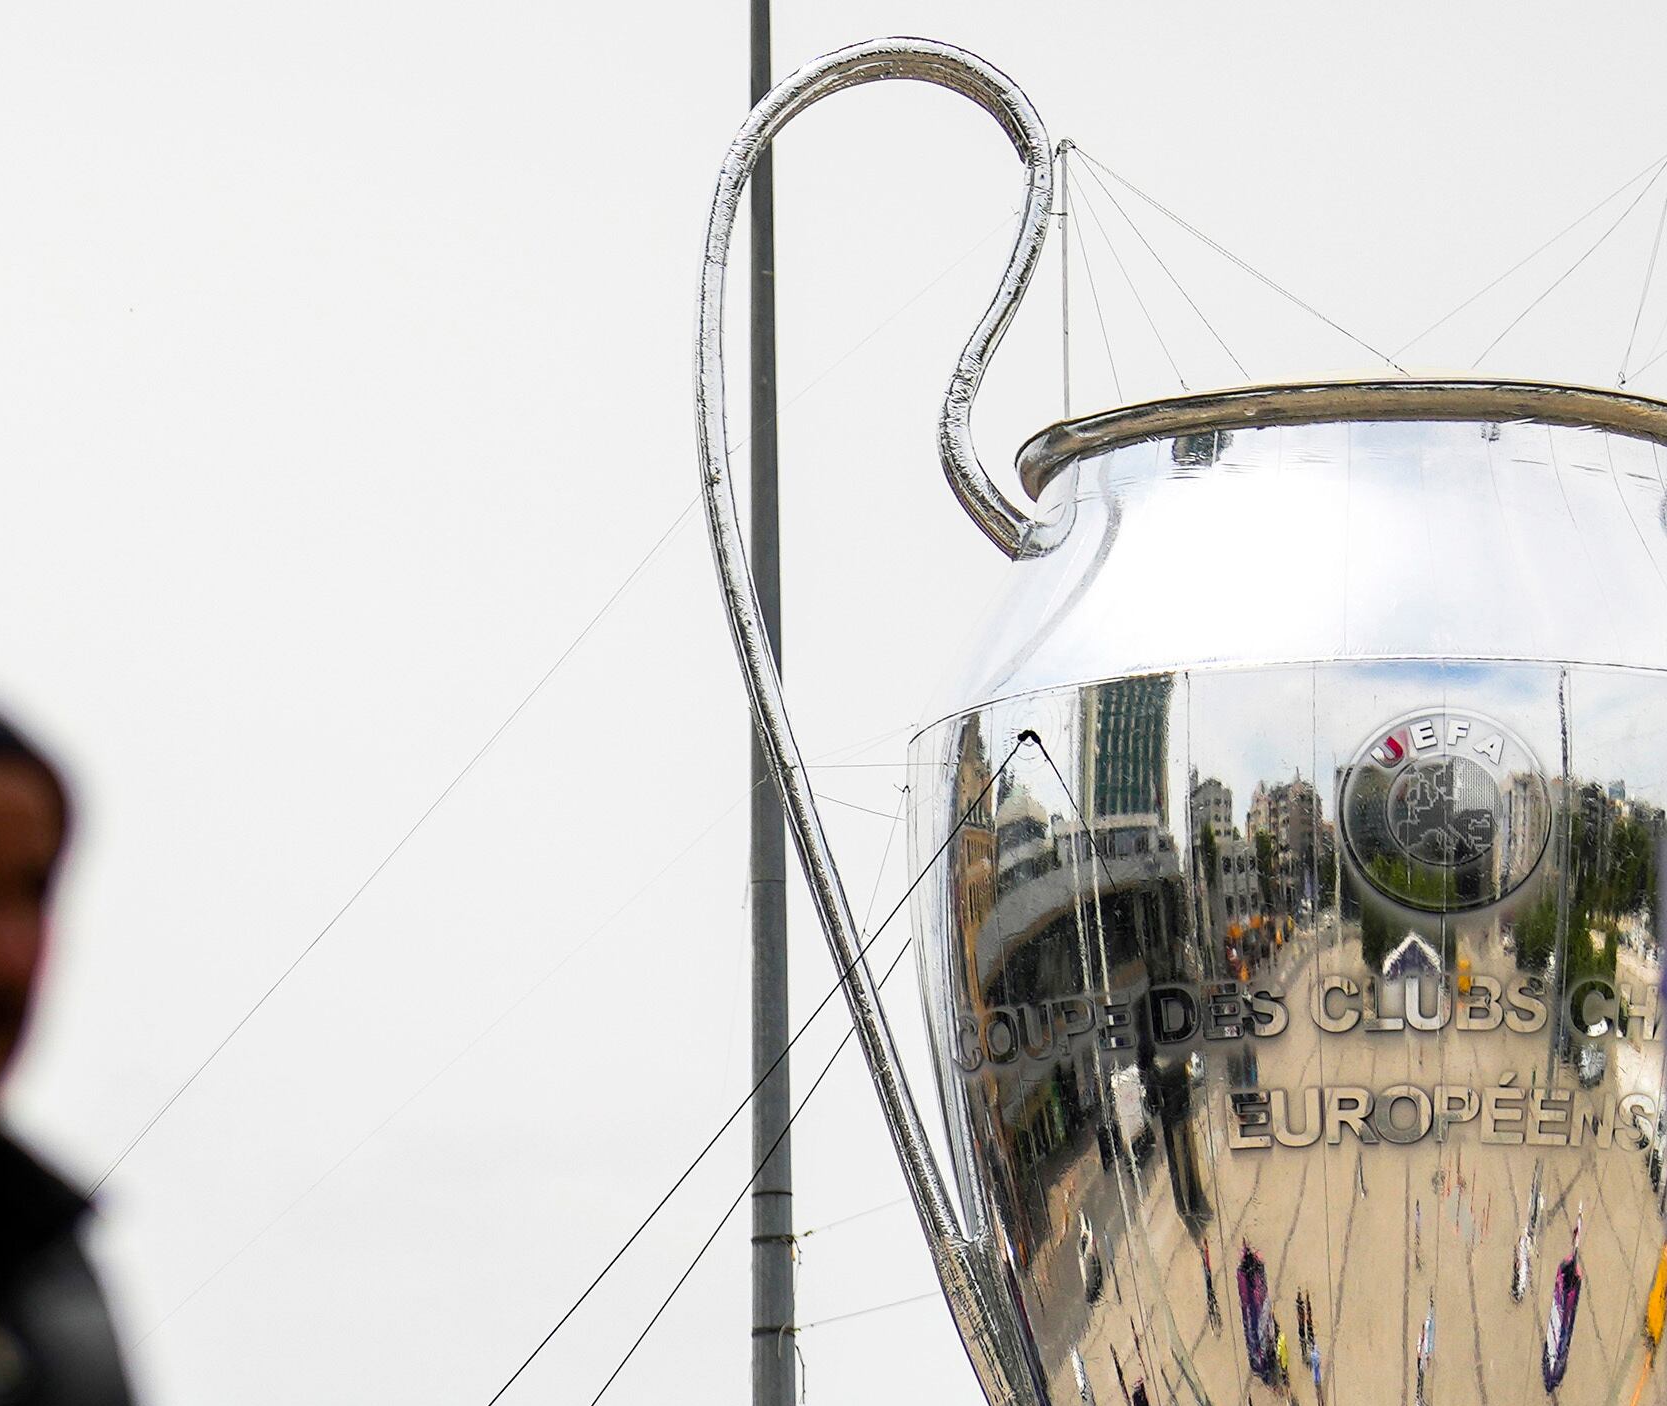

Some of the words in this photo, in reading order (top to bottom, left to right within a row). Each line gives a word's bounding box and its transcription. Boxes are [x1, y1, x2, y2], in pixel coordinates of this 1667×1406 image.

[1370, 716, 1505, 768] UEFA
[955, 989, 1136, 1072] COUPE
[1159, 979, 1287, 1045] DES
[1312, 975, 1548, 1033] CLUBS
[1570, 978, 1667, 1041] CH
[1229, 1071, 1655, 1151] EUROPÉENS
